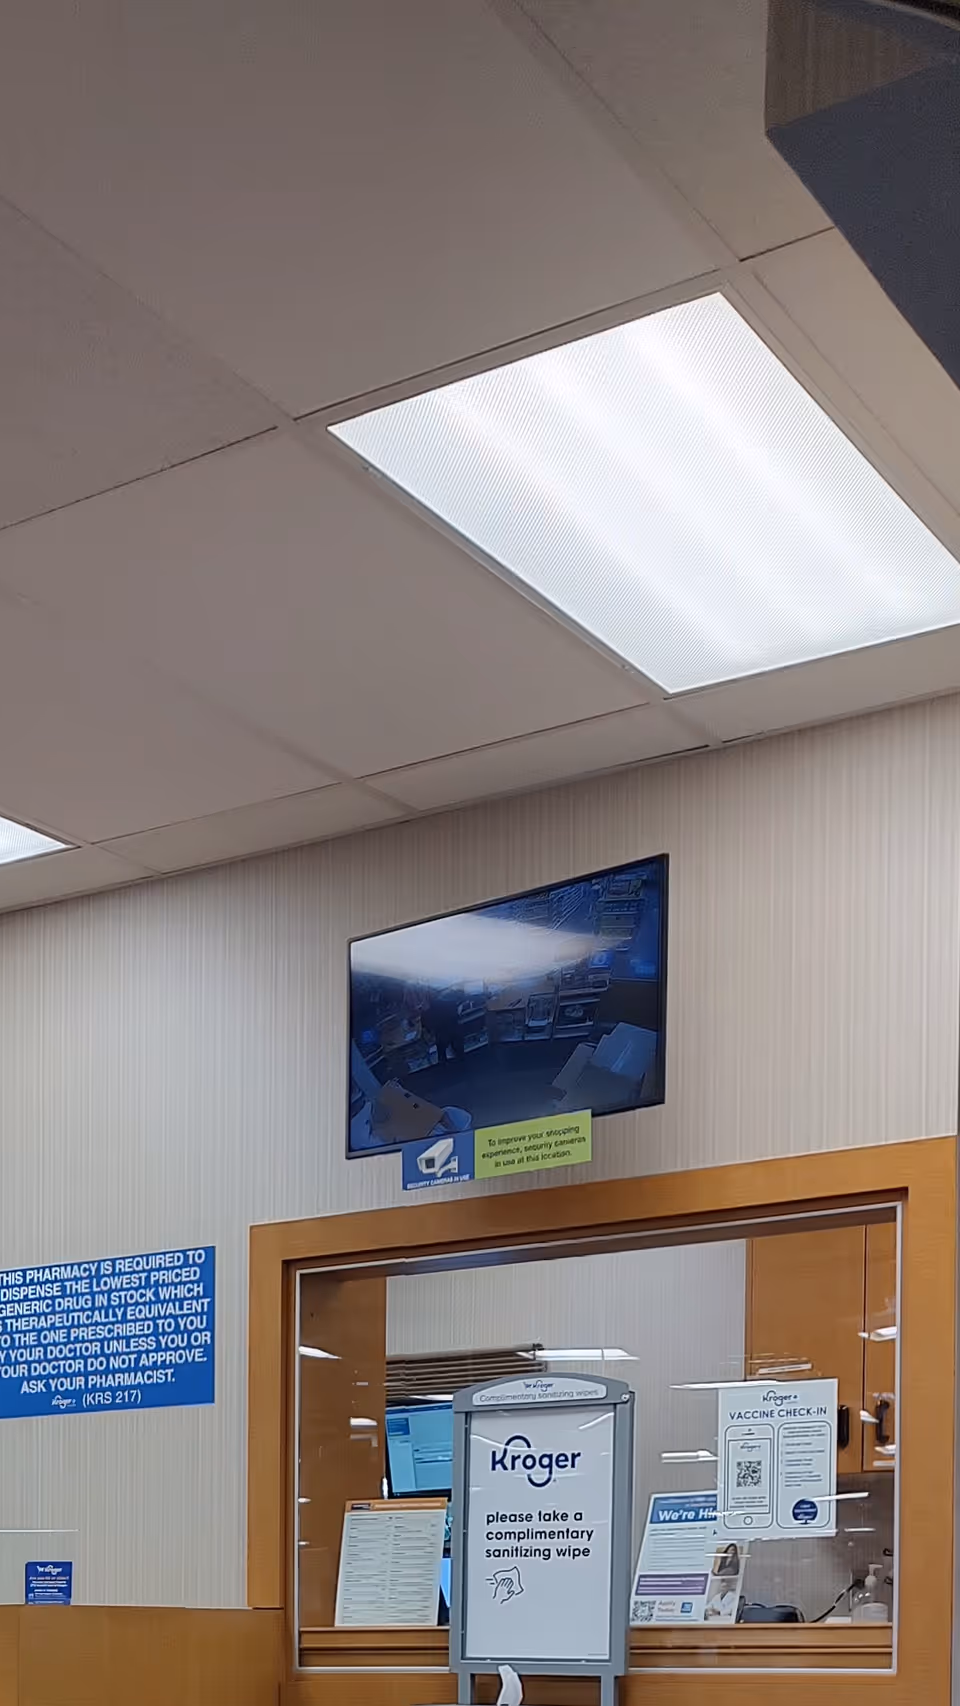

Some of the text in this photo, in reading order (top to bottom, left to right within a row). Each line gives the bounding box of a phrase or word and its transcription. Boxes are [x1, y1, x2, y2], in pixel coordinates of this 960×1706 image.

[482, 1136, 586, 1159] experience, security cameras
[488, 1126, 579, 1147] To improve your shopping
[503, 1158, 515, 1166] use
[526, 1154, 539, 1162] this
[26, 1262, 97, 1284] PHARMACY
[100, 1261, 113, 1274] IS
[116, 1253, 183, 1273] REQUIRED
[187, 1250, 205, 1264] TO
[1, 1267, 200, 1301] DISPENSE THE LOWEST PRICED
[56, 1296, 91, 1311] DRUG
[95, 1294, 107, 1307] IN
[110, 1289, 155, 1305] STOCK
[159, 1283, 203, 1300] WHICH
[5, 1308, 124, 1331] THERAPEUTICALLY
[127, 1299, 210, 1320] EQUIVALENT
[13, 1332, 37, 1346] THE
[40, 1329, 67, 1344] ONE
[70, 1322, 153, 1340] PRESCRIBED
[157, 1319, 175, 1331] TO
[177, 1315, 206, 1330] YOU
[9, 1347, 43, 1362] YOUR
[47, 1342, 100, 1359] DOCTOR
[104, 1338, 156, 1353] UNLESS
[159, 1334, 187, 1348] YOU
[191, 1332, 211, 1345] OR
[31, 1360, 84, 1376] DOCTOR
[87, 1358, 106, 1371] DO
[109, 1355, 137, 1368] NOT
[139, 1349, 207, 1365] APPROVE.
[21, 1369, 175, 1393] ASK YOUR PHARMACIST.
[83, 1392, 112, 1407] (KRS
[115, 1389, 141, 1405] 217)
[480, 1394, 536, 1402] Complimentary
[538, 1391, 574, 1399] sanitizing
[763, 1390, 792, 1406] Kroger
[729, 1407, 827, 1420] VACCINE CHECK-IN
[491, 1435, 581, 1487] Kroger
[486, 1510, 583, 1525] please take a
[659, 1510, 695, 1520] We're
[486, 1528, 594, 1542] complimentary
[485, 1546, 591, 1560] sanitizing wipe
